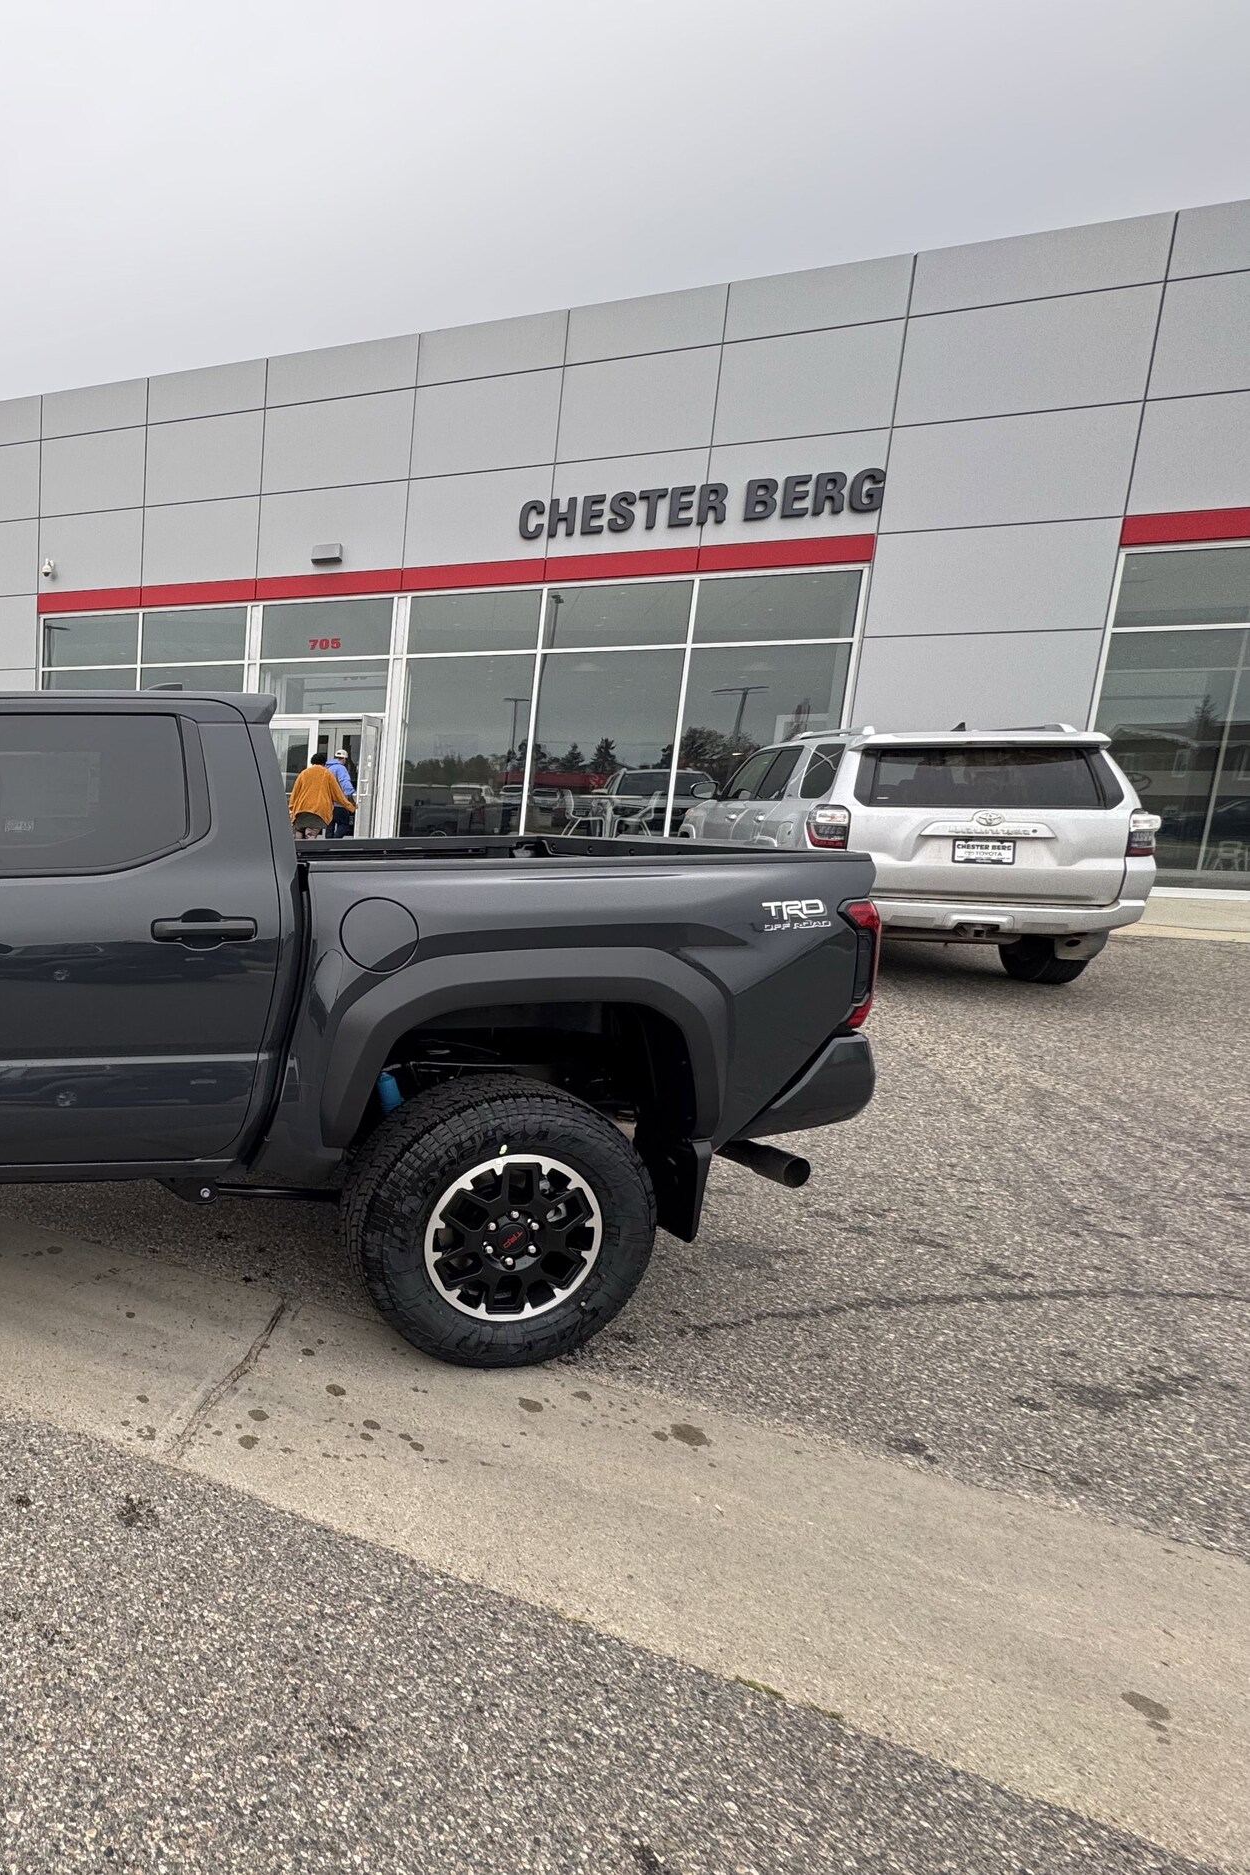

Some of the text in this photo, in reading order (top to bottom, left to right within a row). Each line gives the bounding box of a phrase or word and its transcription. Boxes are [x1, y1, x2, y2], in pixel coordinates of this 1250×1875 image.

[519, 467, 887, 540] CHESTER BERG
[309, 637, 341, 650] 705
[761, 899, 826, 921] TRD
[764, 920, 832, 932] OFF ROAD
[502, 1231, 524, 1249] TRD
